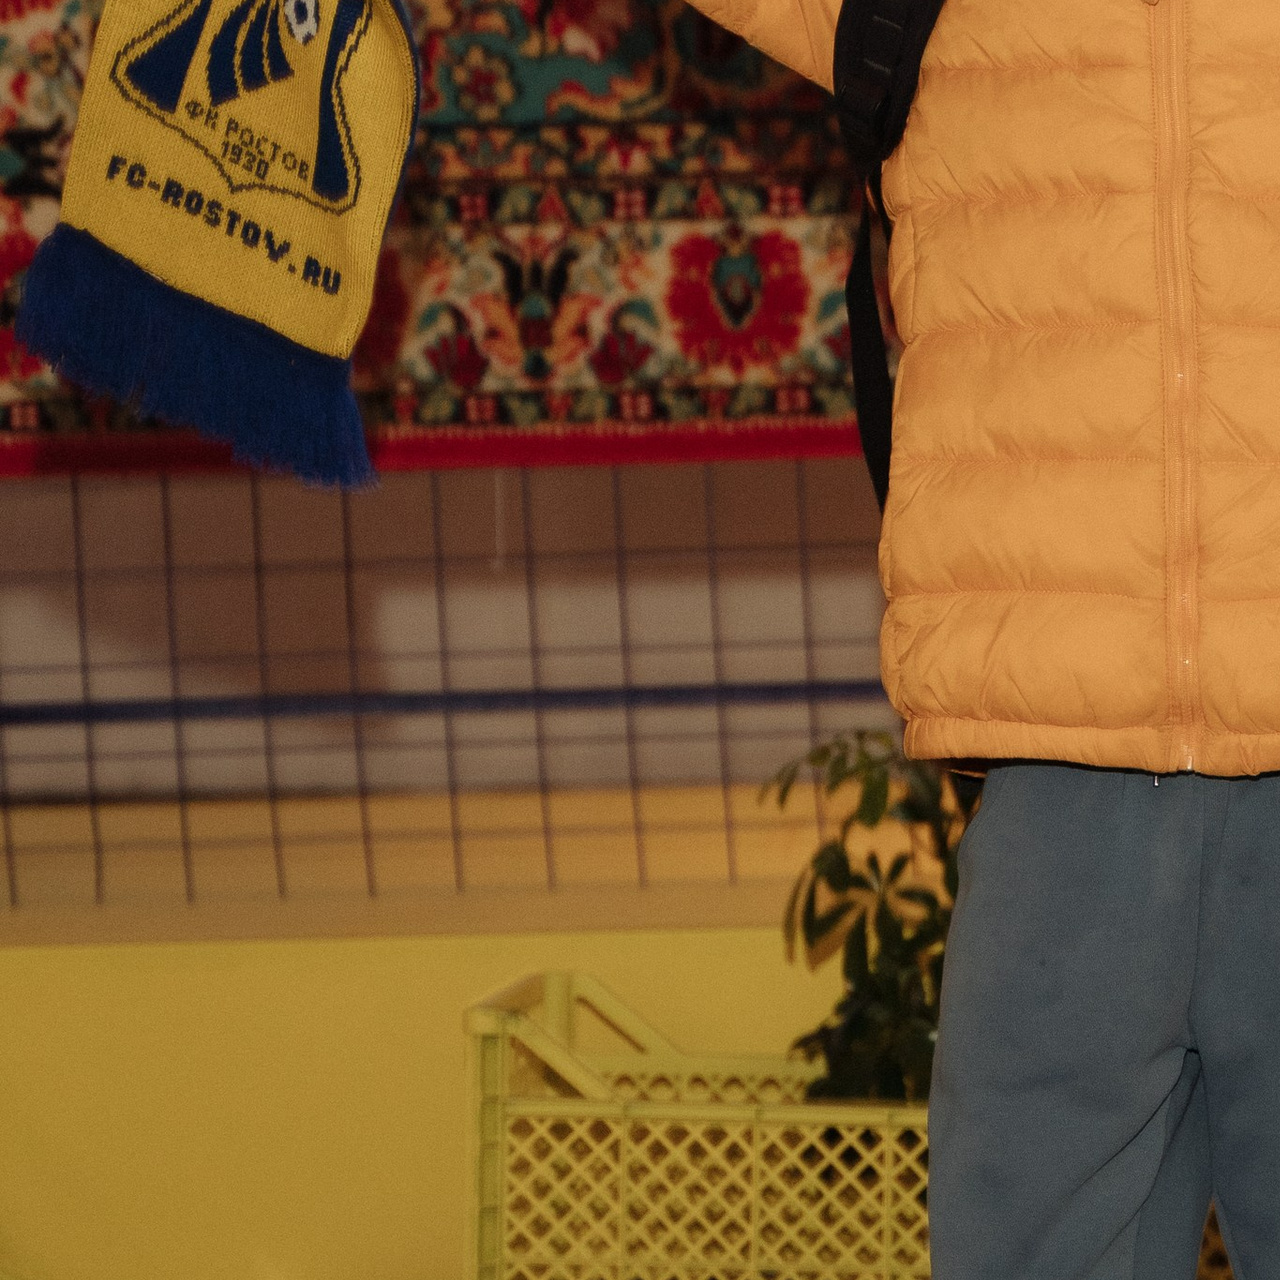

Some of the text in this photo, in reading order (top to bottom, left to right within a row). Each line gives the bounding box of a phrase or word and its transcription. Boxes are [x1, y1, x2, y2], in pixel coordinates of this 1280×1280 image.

[221, 140, 270, 180] 1930
[225, 117, 309, 180] РОСТОВ
[105, 154, 341, 296] FC-ROSTOV.RU
